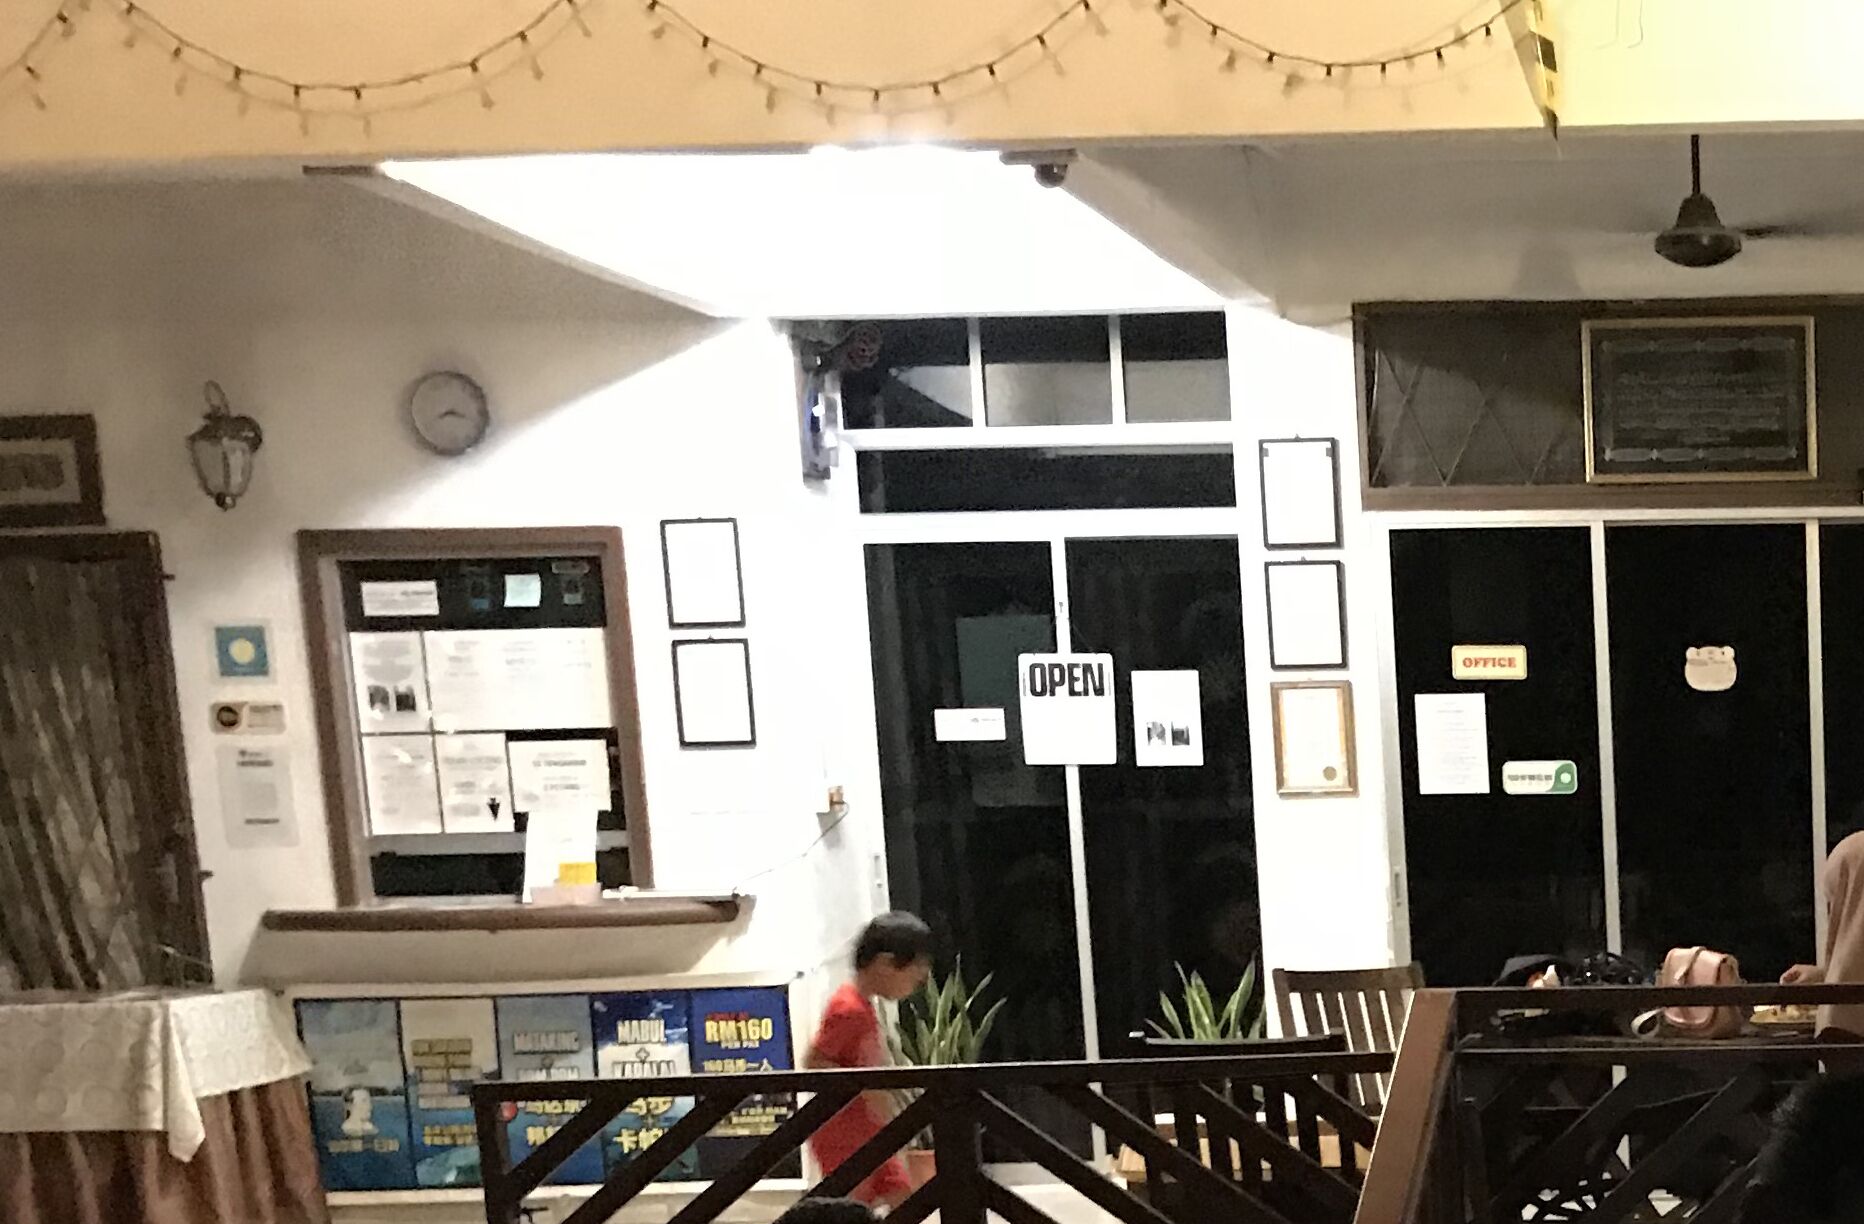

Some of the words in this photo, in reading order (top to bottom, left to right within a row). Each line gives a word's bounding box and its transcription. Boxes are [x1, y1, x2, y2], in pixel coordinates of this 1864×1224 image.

[1462, 656, 1517, 668] OFFICE
[1029, 662, 1105, 697] OPEN
[617, 1019, 666, 1043] MABUL
[705, 1017, 773, 1043] RM160
